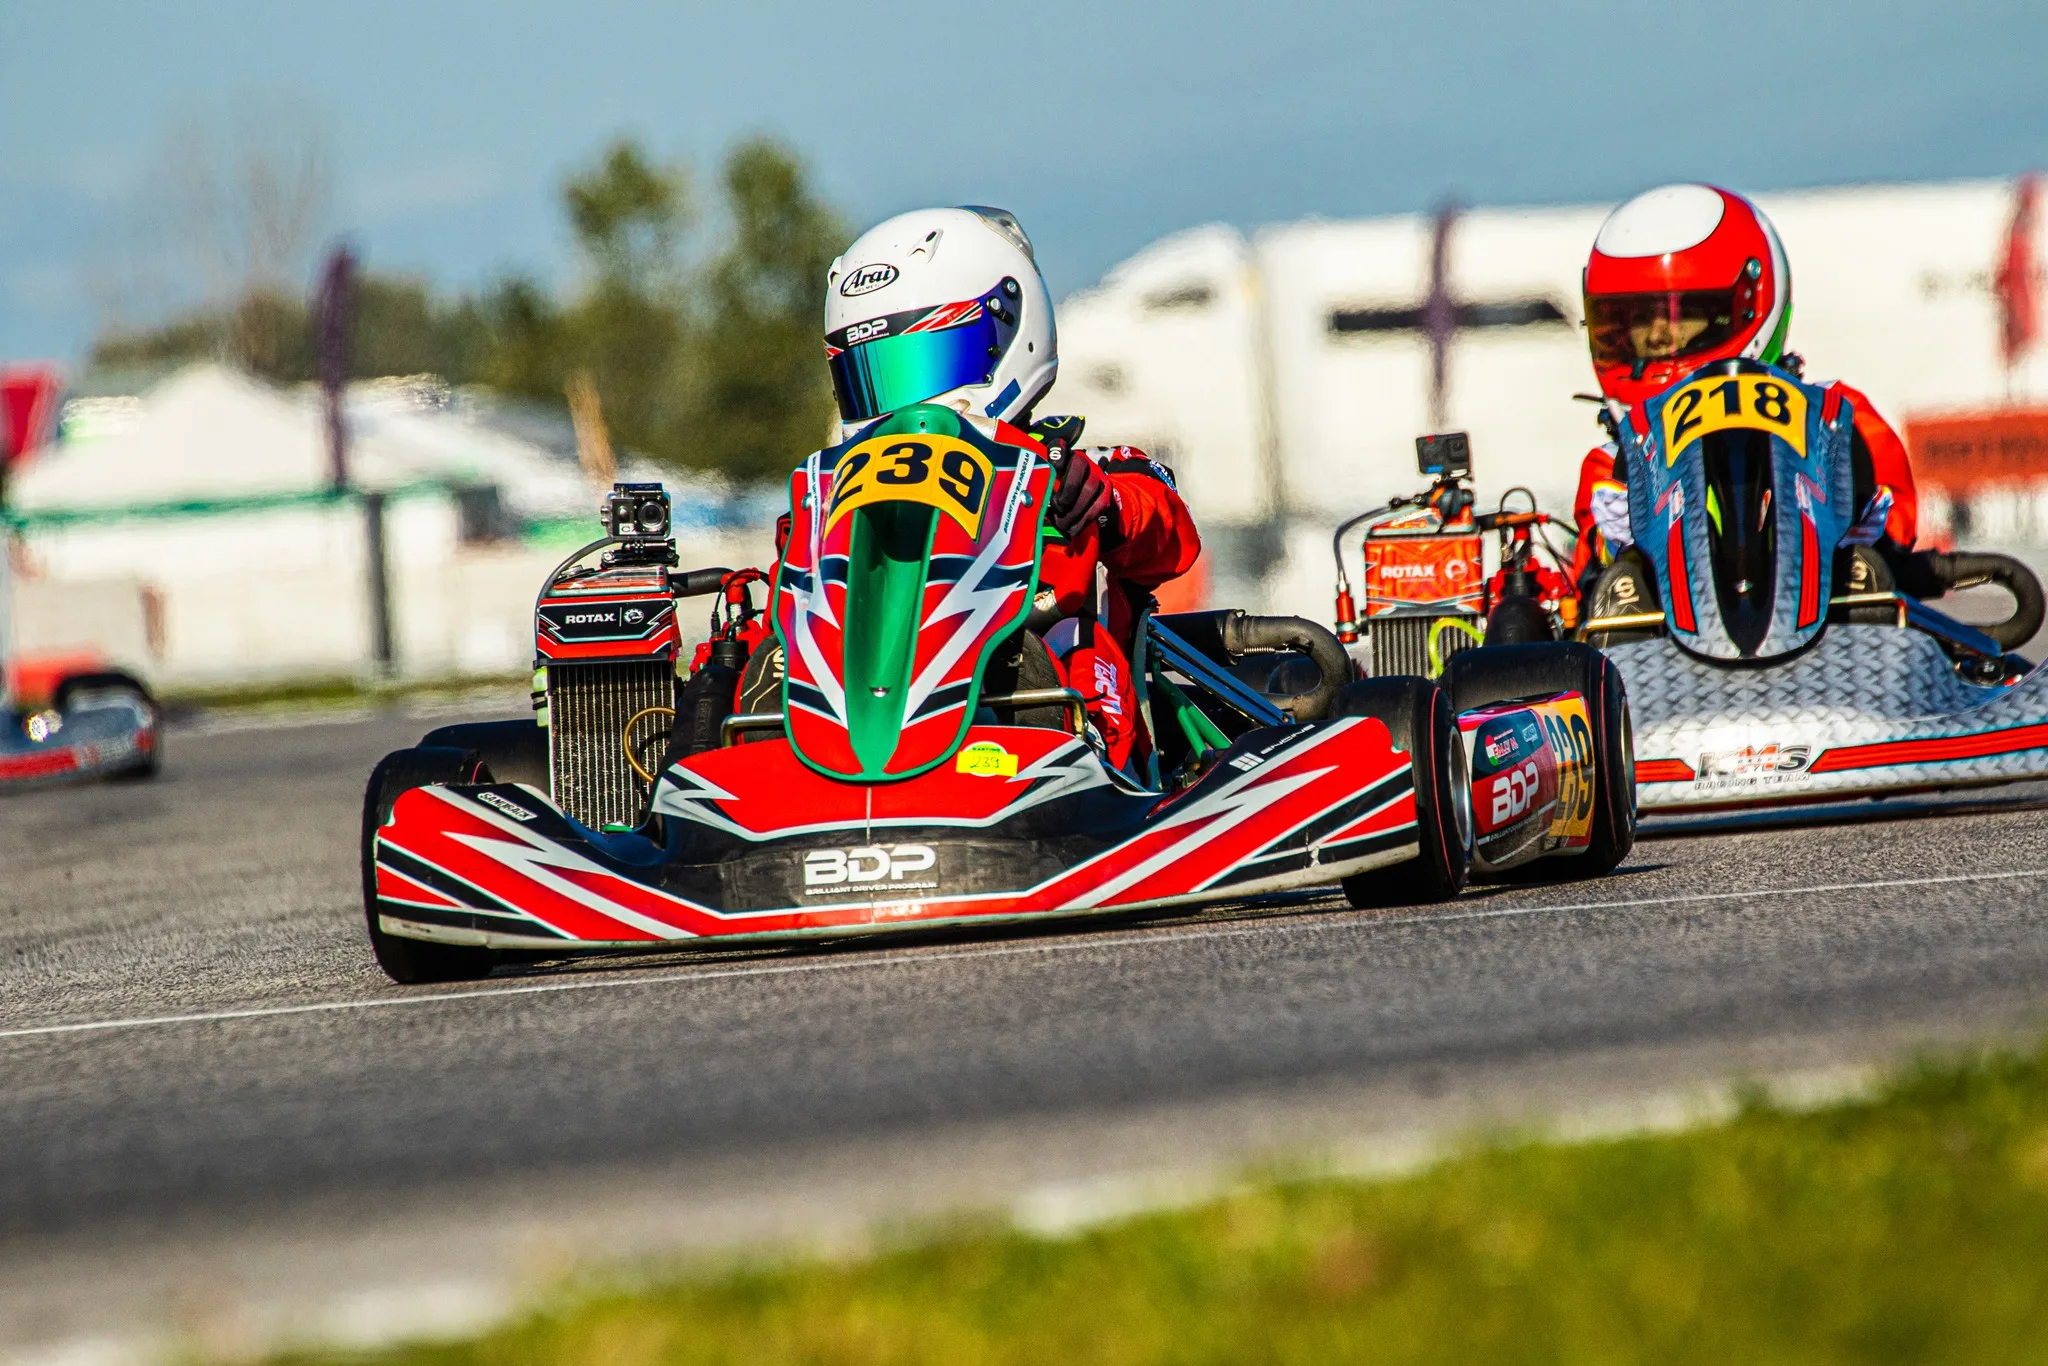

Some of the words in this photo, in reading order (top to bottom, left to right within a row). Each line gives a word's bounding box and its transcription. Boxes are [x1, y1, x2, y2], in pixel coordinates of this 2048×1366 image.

[844, 266, 890, 293] Arai
[847, 318, 888, 342] BDP
[1672, 380, 1792, 448] 218
[829, 442, 985, 520] 239
[1381, 564, 1435, 579] ROTAX
[565, 613, 615, 625] ROTAX
[970, 755, 999, 768] 239
[1763, 772, 1811, 784] TEAM
[1492, 761, 1539, 825] BDP
[805, 845, 936, 885] BDP
[805, 886, 851, 896] BRILLIANT
[852, 884, 887, 892] DRIVER
[888, 881, 937, 890] PROGRAM
